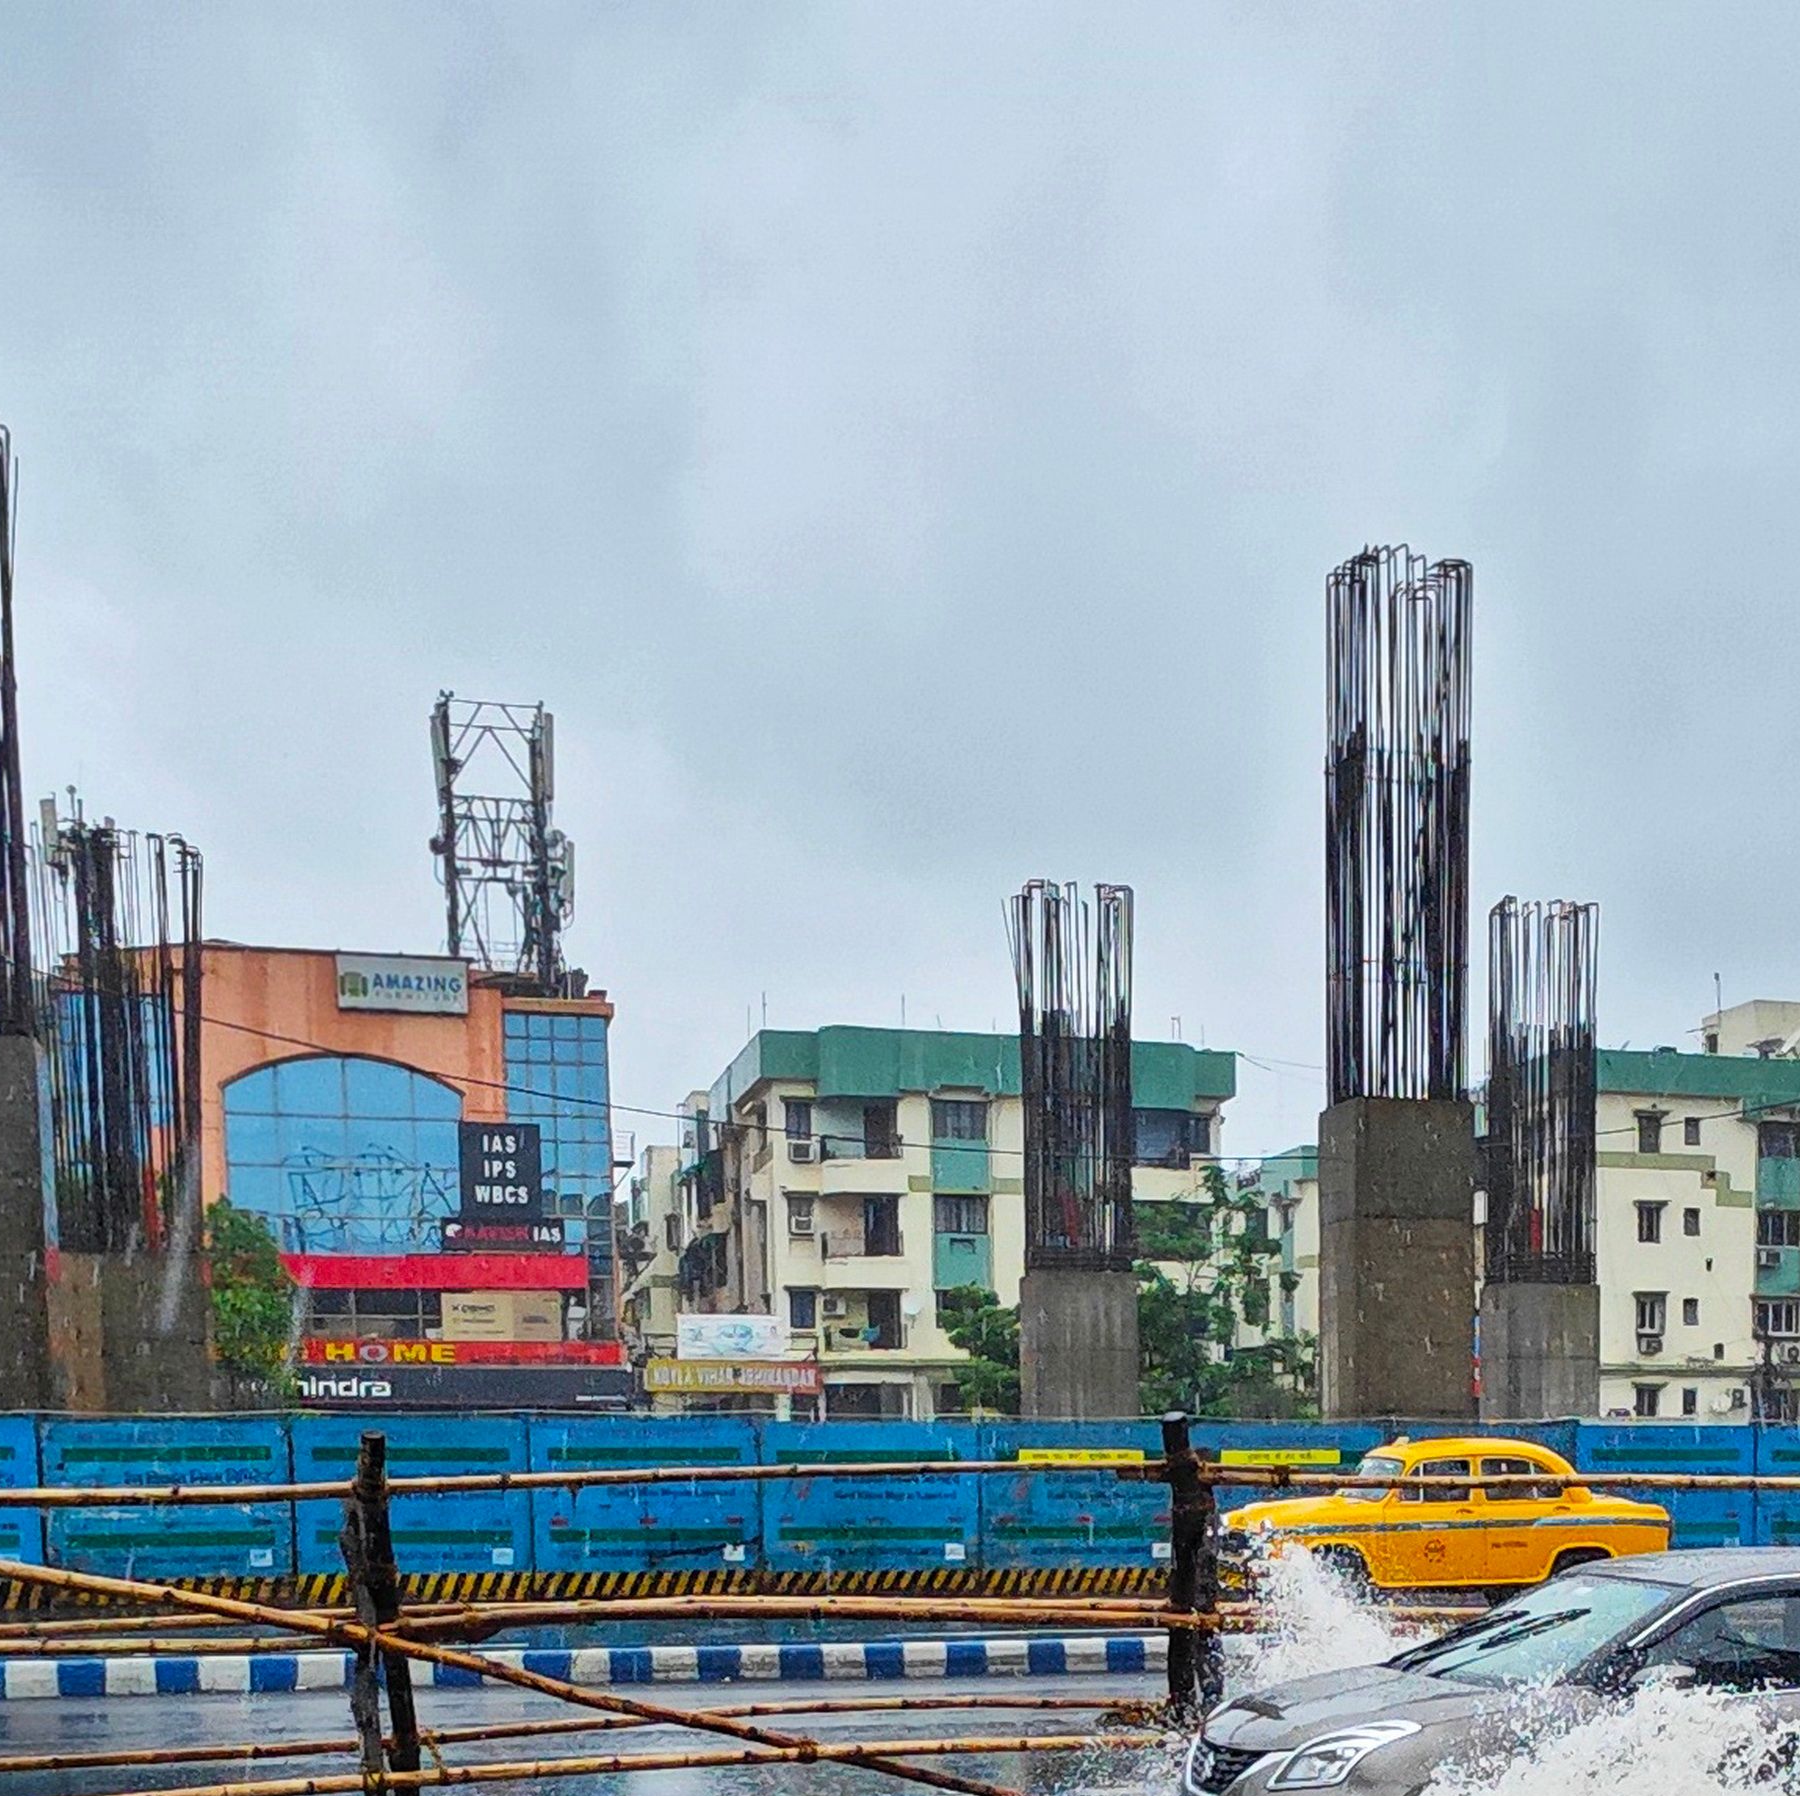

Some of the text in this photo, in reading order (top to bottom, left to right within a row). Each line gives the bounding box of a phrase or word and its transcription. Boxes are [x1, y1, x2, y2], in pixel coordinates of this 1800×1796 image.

[372, 973, 462, 994] AMAZING
[482, 1134, 517, 1154] IAS
[483, 1160, 517, 1179] IPS
[474, 1185, 529, 1204] WBCS
[532, 1226, 561, 1243] IAS
[325, 1342, 456, 1363] HOME
